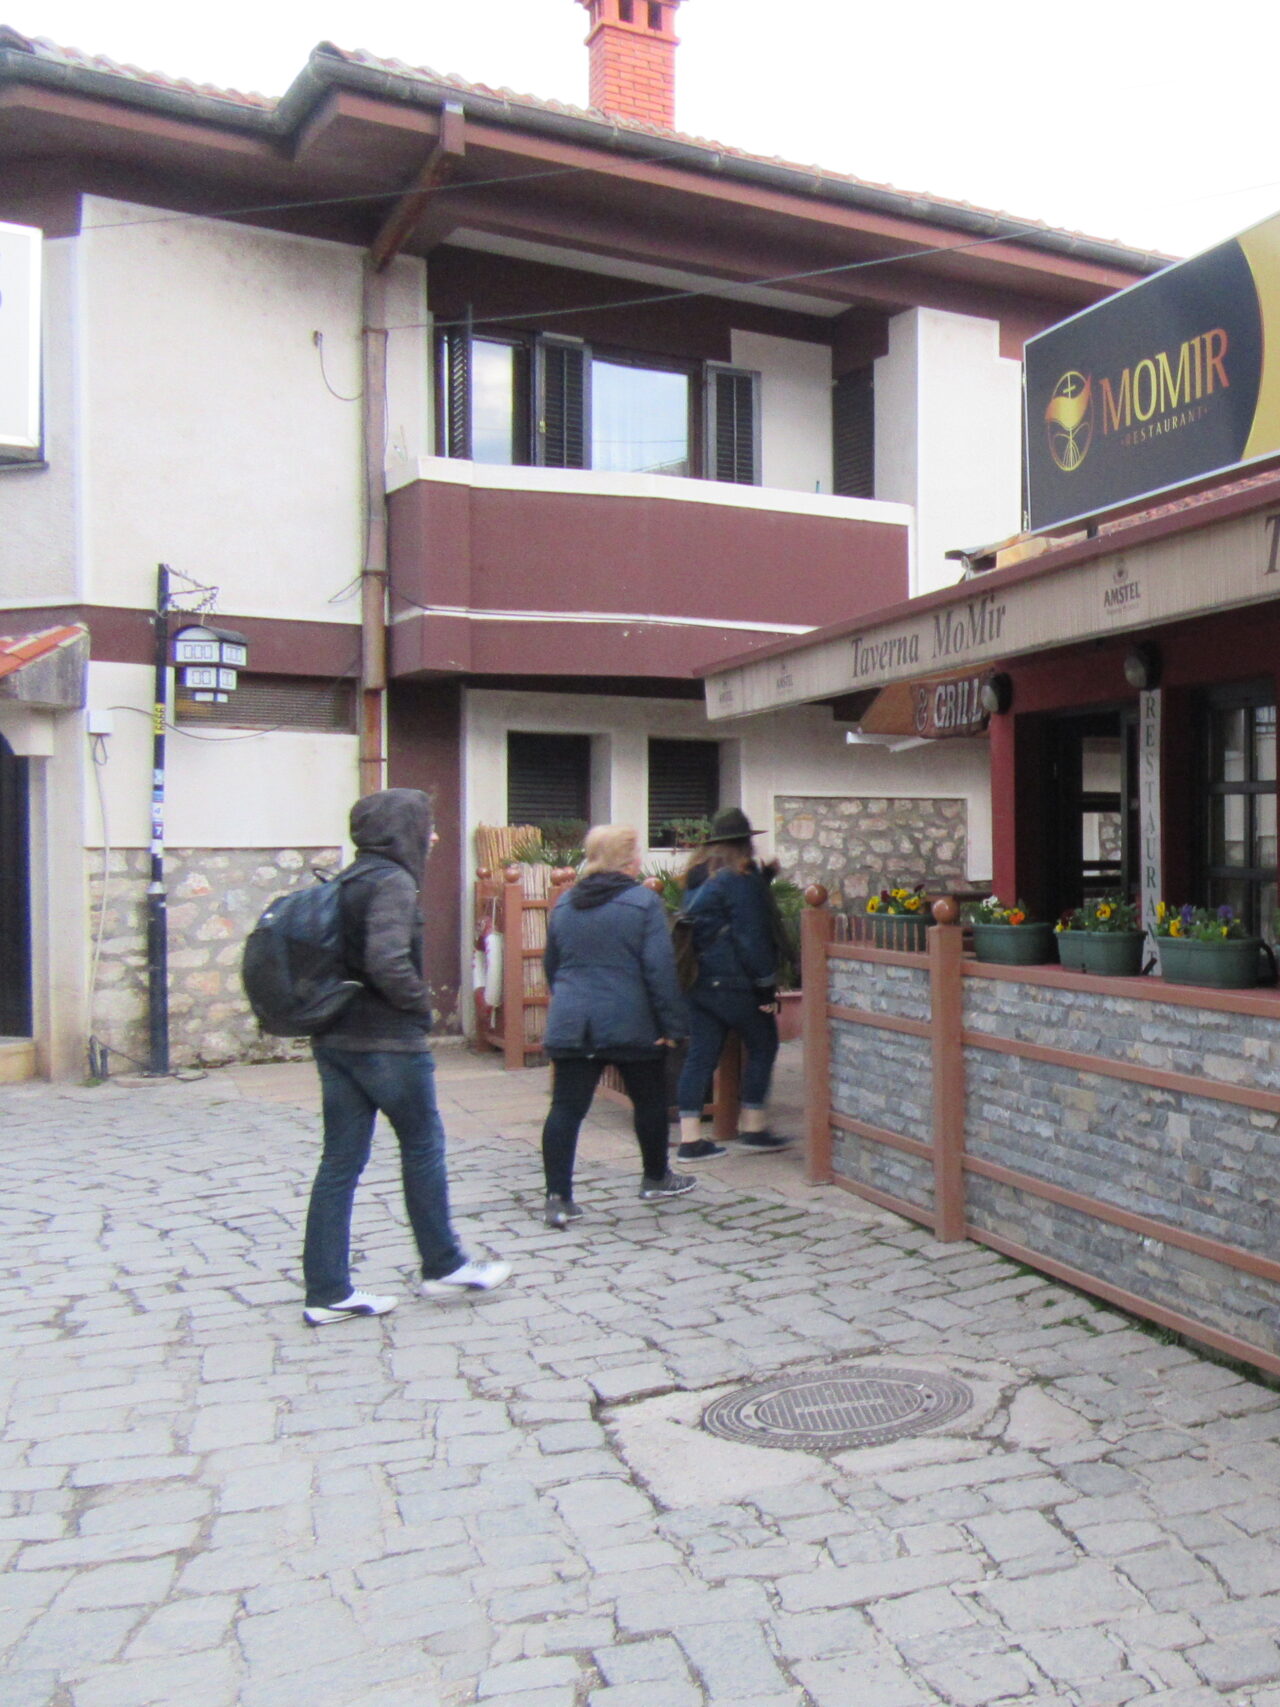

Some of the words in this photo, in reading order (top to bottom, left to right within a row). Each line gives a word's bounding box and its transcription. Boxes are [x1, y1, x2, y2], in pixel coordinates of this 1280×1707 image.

[1099, 328, 1229, 436] MOMIR
[1104, 582, 1141, 608] AMSTEL
[851, 637, 920, 678] Taverna
[931, 593, 1006, 659] MoMir
[915, 687, 929, 732] &
[934, 678, 983, 729] GRILL
